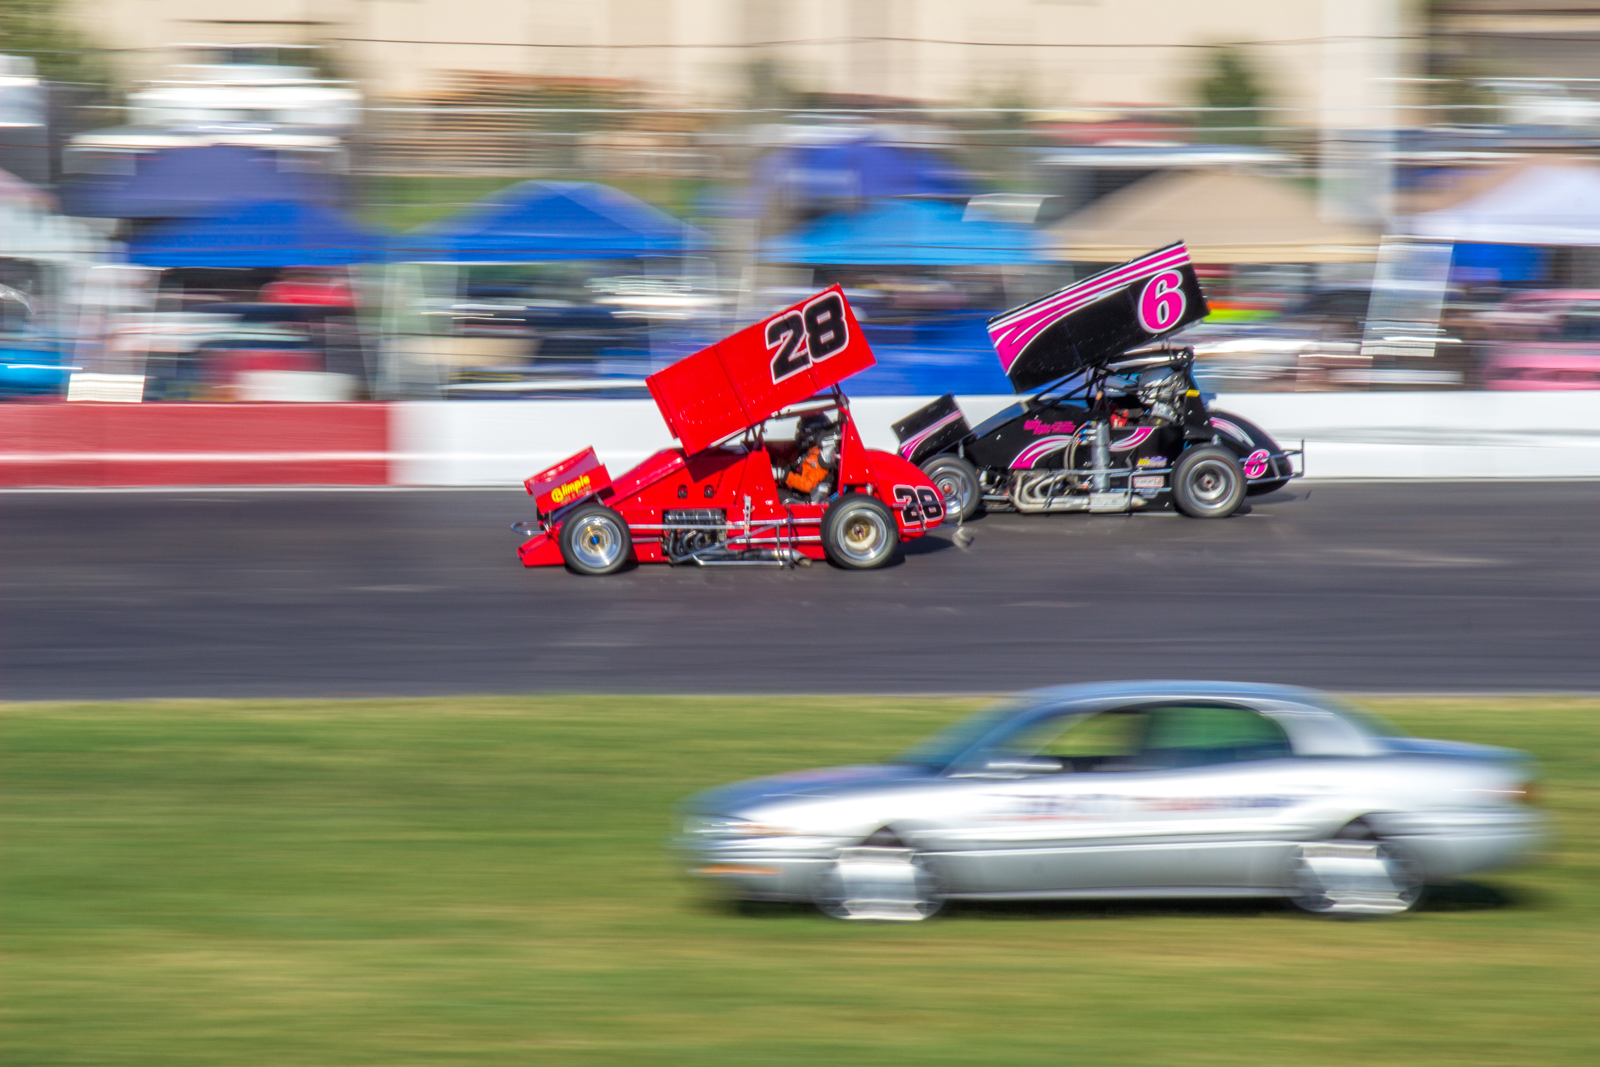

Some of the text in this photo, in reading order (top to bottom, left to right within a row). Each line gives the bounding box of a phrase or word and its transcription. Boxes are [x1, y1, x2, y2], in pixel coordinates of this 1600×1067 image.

[1137, 269, 1187, 333] 6
[765, 291, 849, 385] 28
[1243, 449, 1270, 479] 6
[551, 475, 590, 503] Blimpie
[893, 484, 944, 526] 28
